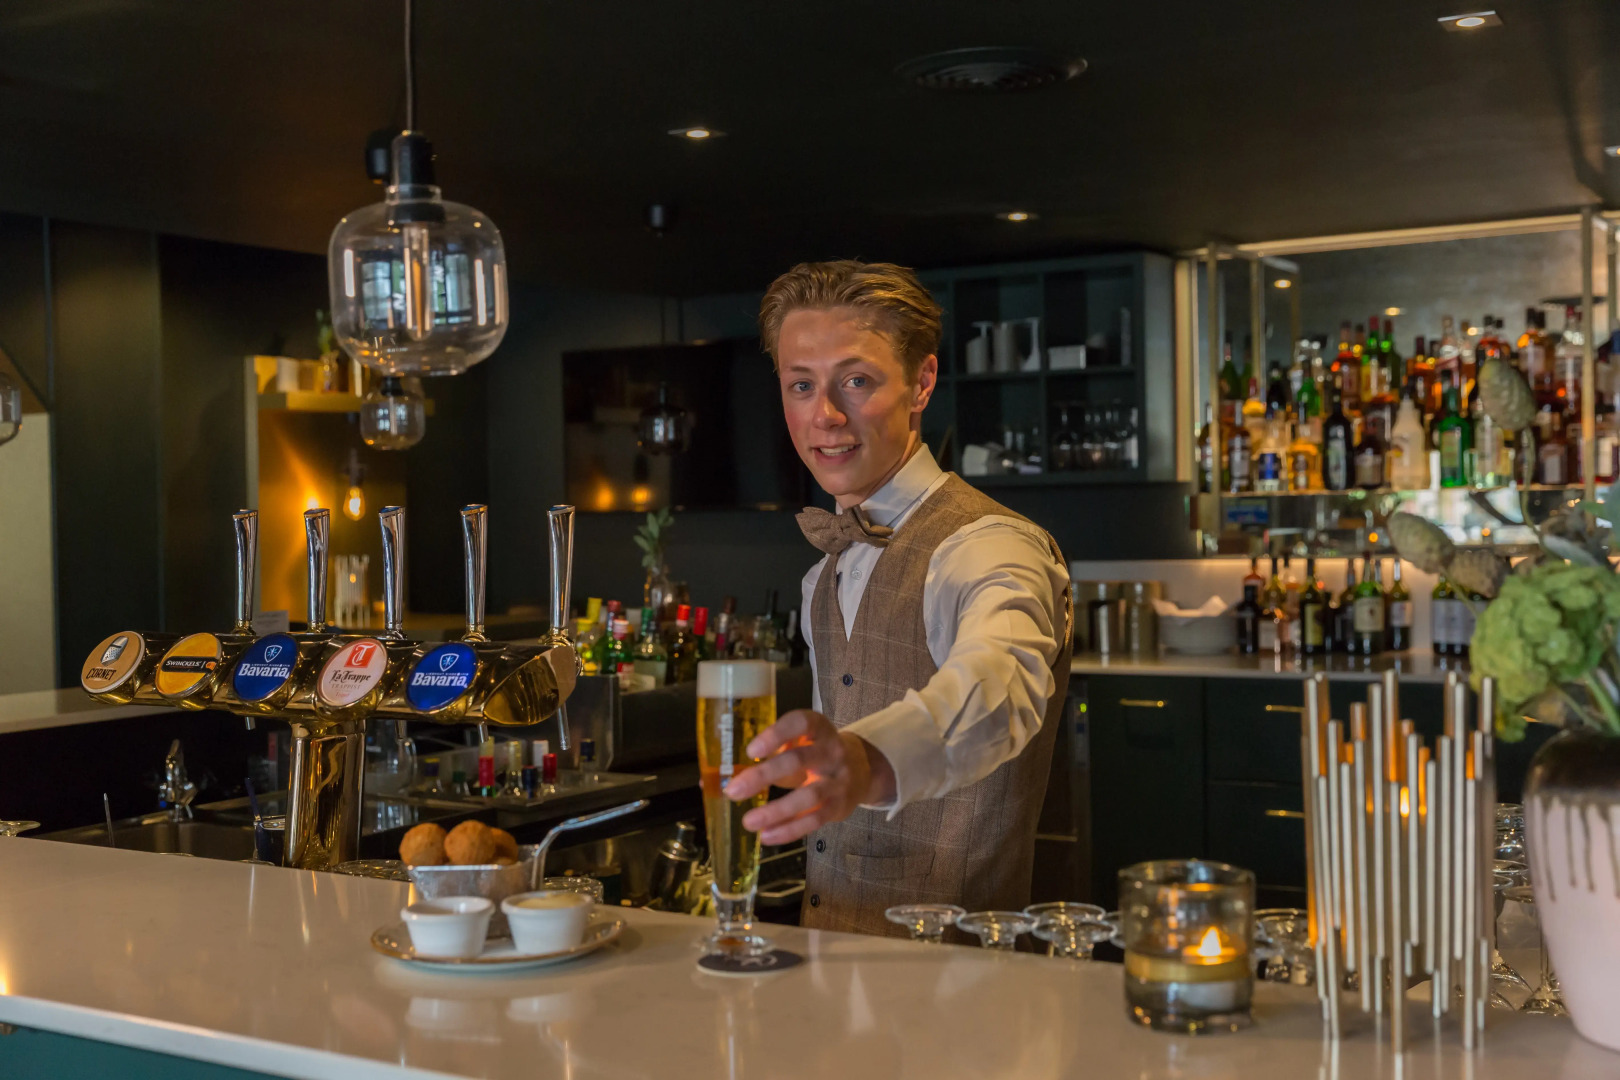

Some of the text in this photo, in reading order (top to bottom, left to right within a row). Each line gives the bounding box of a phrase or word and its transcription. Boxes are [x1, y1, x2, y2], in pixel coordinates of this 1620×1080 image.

[86, 667, 117, 681] CORNET
[238, 663, 289, 679] Bavaria
[329, 669, 371, 683] La Trappe
[411, 672, 468, 688] Bavaria
